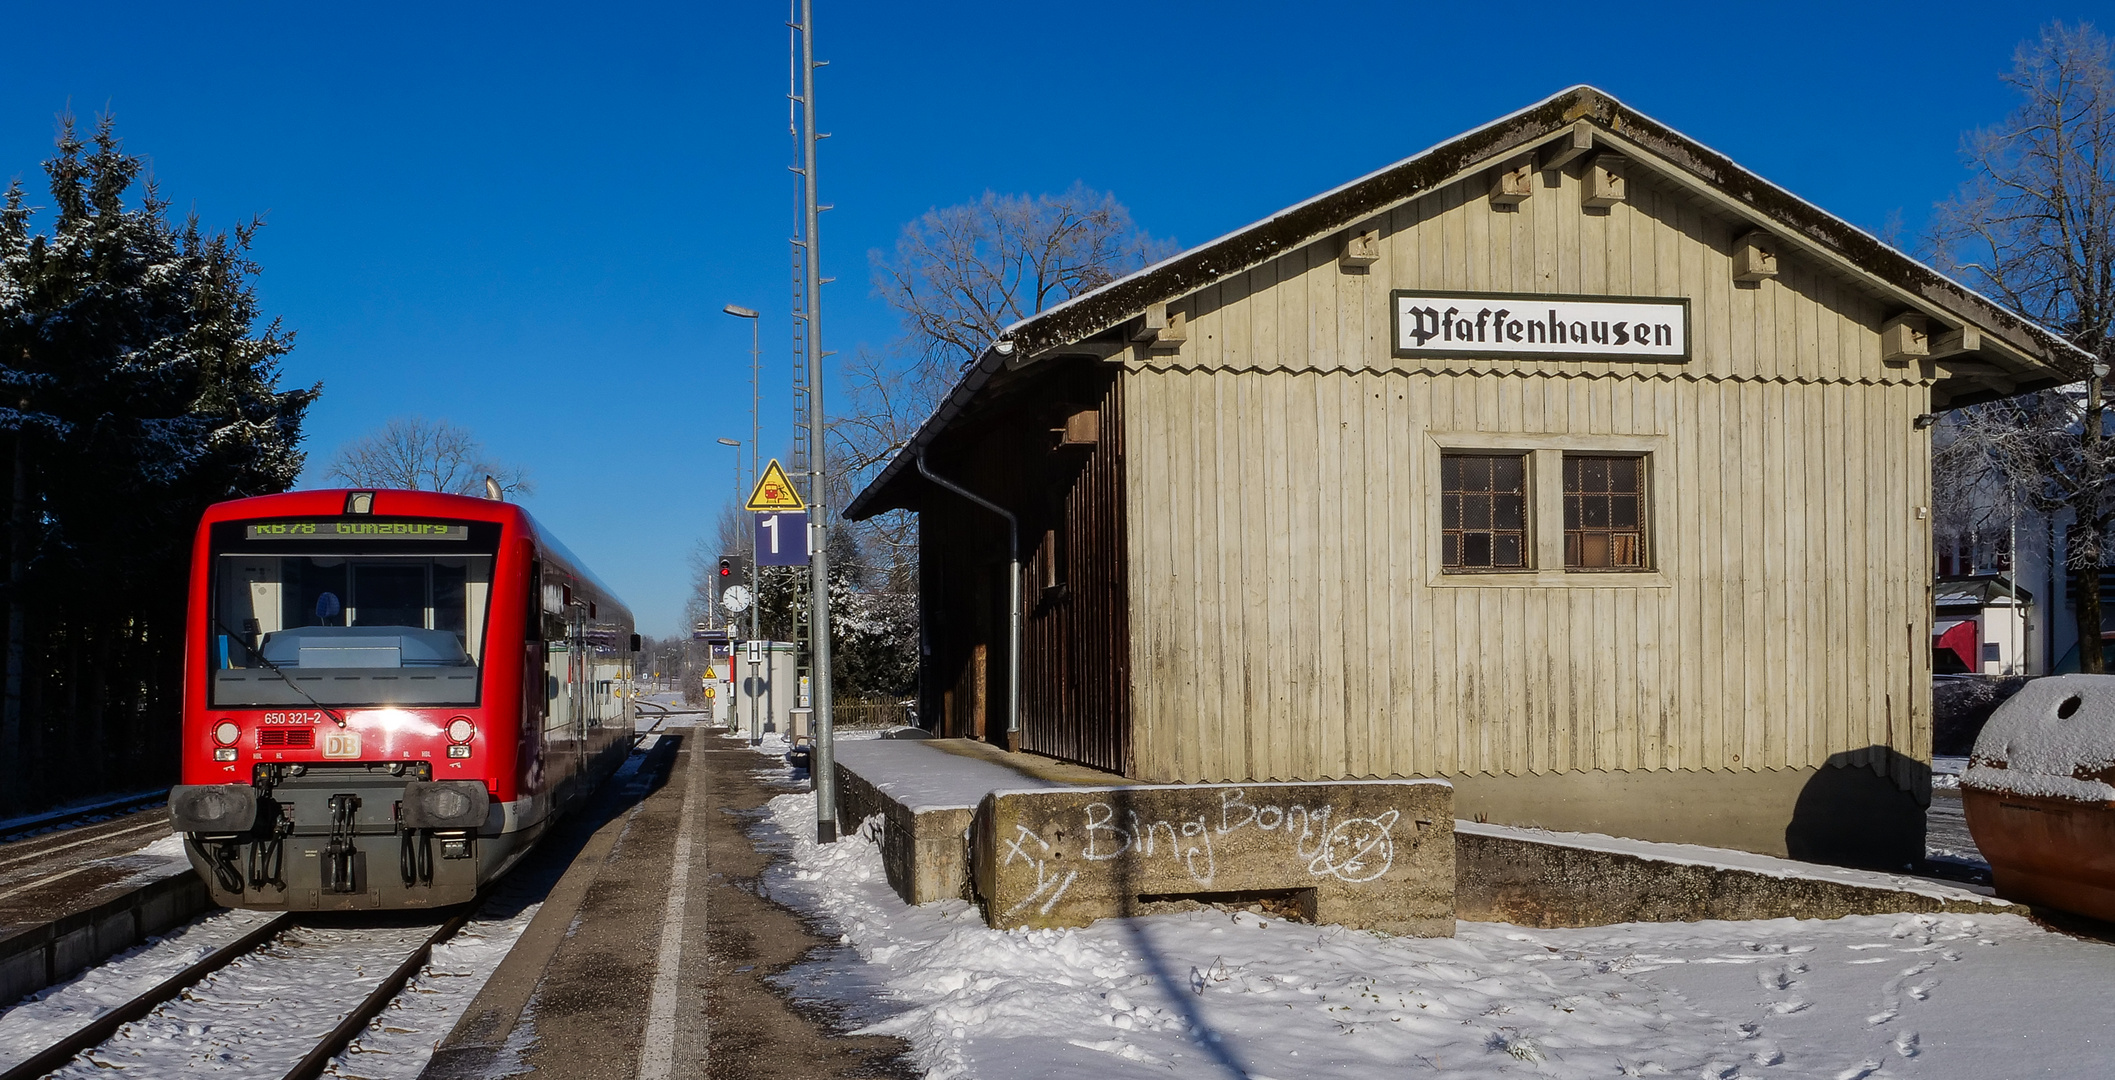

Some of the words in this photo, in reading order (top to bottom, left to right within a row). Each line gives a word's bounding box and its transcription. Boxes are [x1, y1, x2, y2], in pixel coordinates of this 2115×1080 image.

[1408, 305, 1672, 347] Pfaffenhausen
[762, 514, 779, 554] 1
[748, 642, 760, 660] H
[264, 712, 286, 725] 650
[288, 712, 322, 724] 321-2
[328, 736, 357, 755] DB
[1082, 802, 1216, 886] Bing
[1215, 787, 1333, 859] Bong
